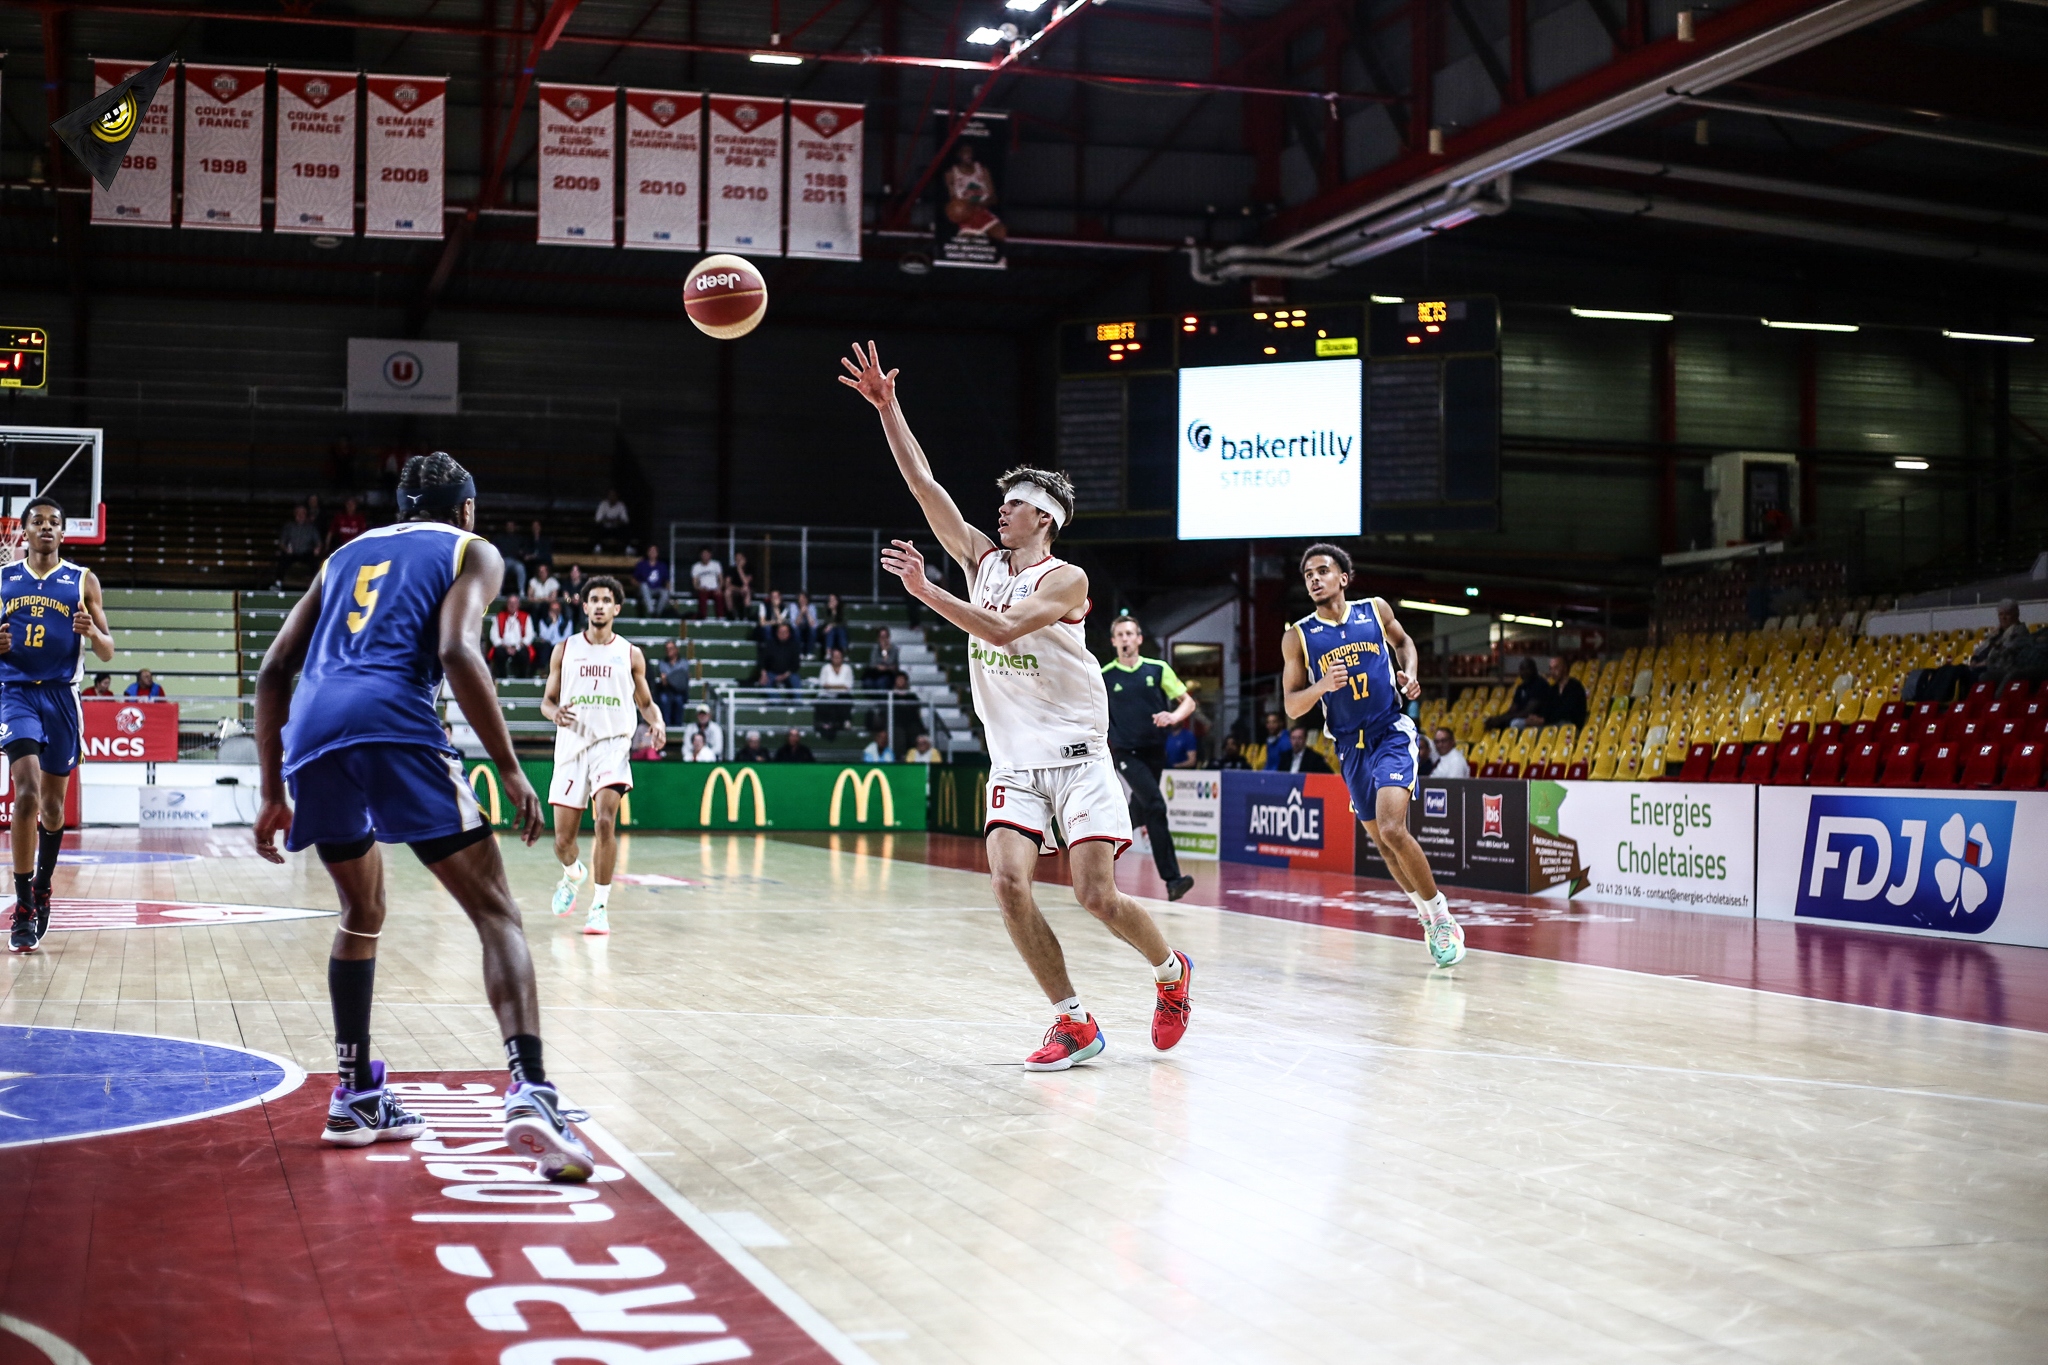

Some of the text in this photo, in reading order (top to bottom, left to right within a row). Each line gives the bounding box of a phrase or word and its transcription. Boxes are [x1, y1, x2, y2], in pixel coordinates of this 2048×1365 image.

[195, 106, 236, 117] COUPE
[288, 111, 328, 122] COUPE
[198, 117, 250, 129] FRANCE
[291, 122, 343, 134] FRANCE
[377, 116, 435, 127] SEMAINE
[407, 128, 426, 139] AS
[548, 124, 606, 136] FINALISTE
[543, 146, 610, 158] CHALLENGE
[121, 155, 157, 170] 986
[199, 158, 247, 174] 1998
[292, 163, 340, 179] 1999
[382, 168, 429, 184] 2008
[553, 175, 601, 191] 2009
[639, 180, 687, 196] 2010
[722, 185, 768, 201] 2010
[802, 188, 847, 204] 2011
[696, 273, 741, 291] Jeep
[1221, 430, 1353, 465] bakertilly
[346, 560, 392, 634] 5
[5, 595, 70, 618] METROPOLITANS
[30, 605, 45, 618] 92
[24, 623, 46, 648] 12
[1317, 641, 1380, 678] METROPOLITANS
[1344, 653, 1360, 667] 92
[580, 665, 612, 678] CHOLET
[593, 679, 598, 691] 7
[1348, 672, 1370, 700] 17
[565, 779, 574, 796] 7
[992, 785, 1005, 809] 6
[1249, 787, 1320, 842] ARTIPÔLE
[1631, 793, 1712, 837] Energies
[1617, 841, 1727, 881] Choletaises
[1809, 815, 1927, 906] FDJ
[1597, 883, 1604, 894] 02
[1606, 884, 1613, 895] 41
[1624, 885, 1632, 896] 14
[1646, 888, 1749, 907] contact@energies-choletaises.fr
